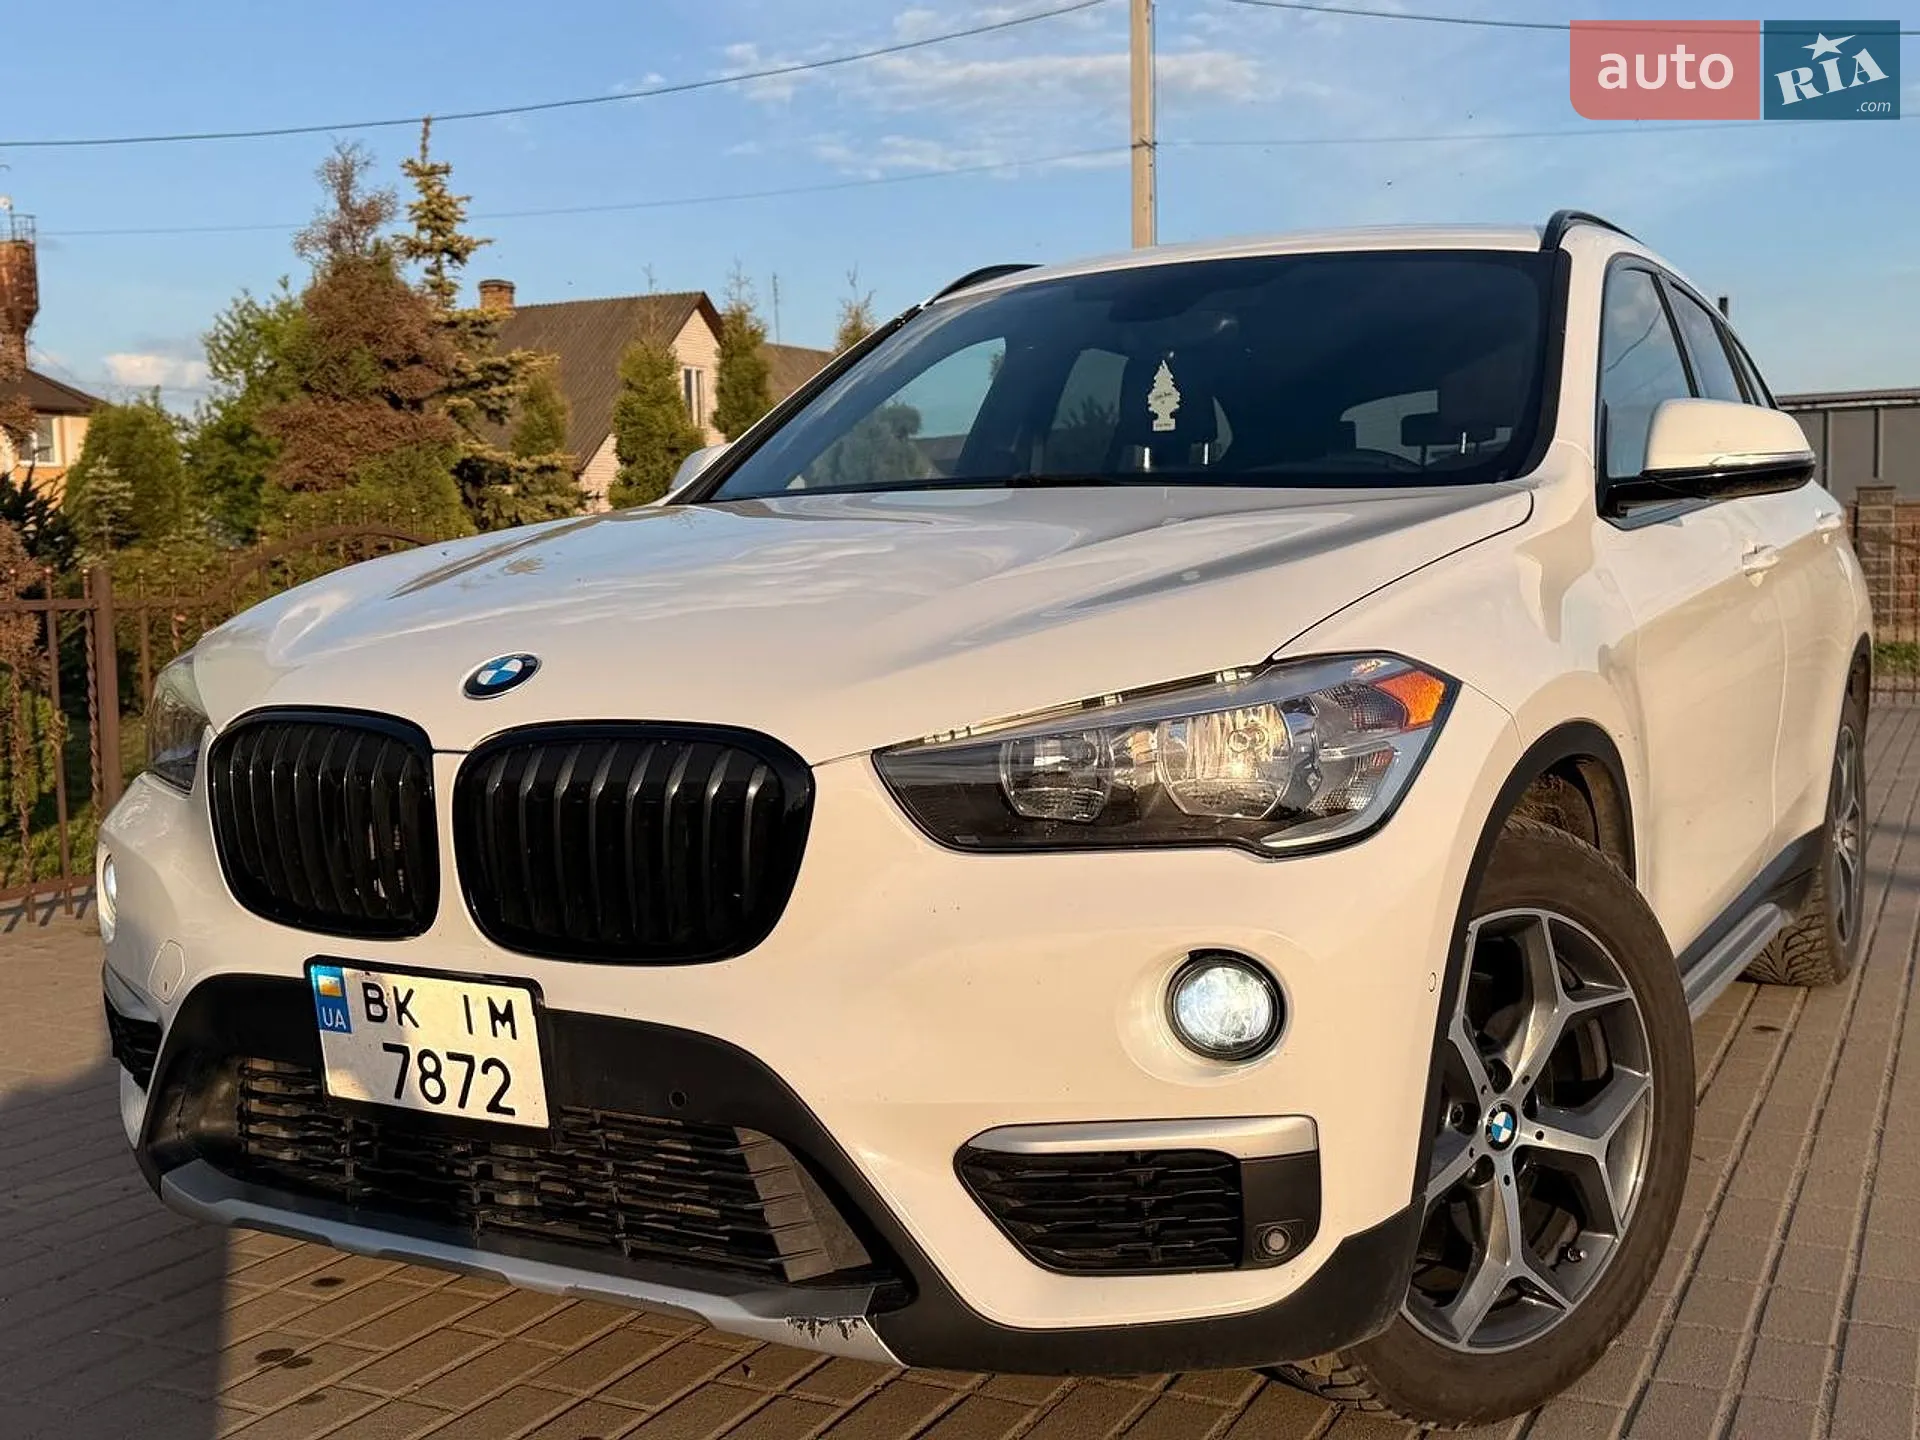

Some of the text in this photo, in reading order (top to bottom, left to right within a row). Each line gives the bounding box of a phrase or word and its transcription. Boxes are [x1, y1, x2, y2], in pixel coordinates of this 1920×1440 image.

[322, 1006, 347, 1030] UA
[362, 982, 517, 1040] BK IM
[382, 1042, 516, 1116] 7872
